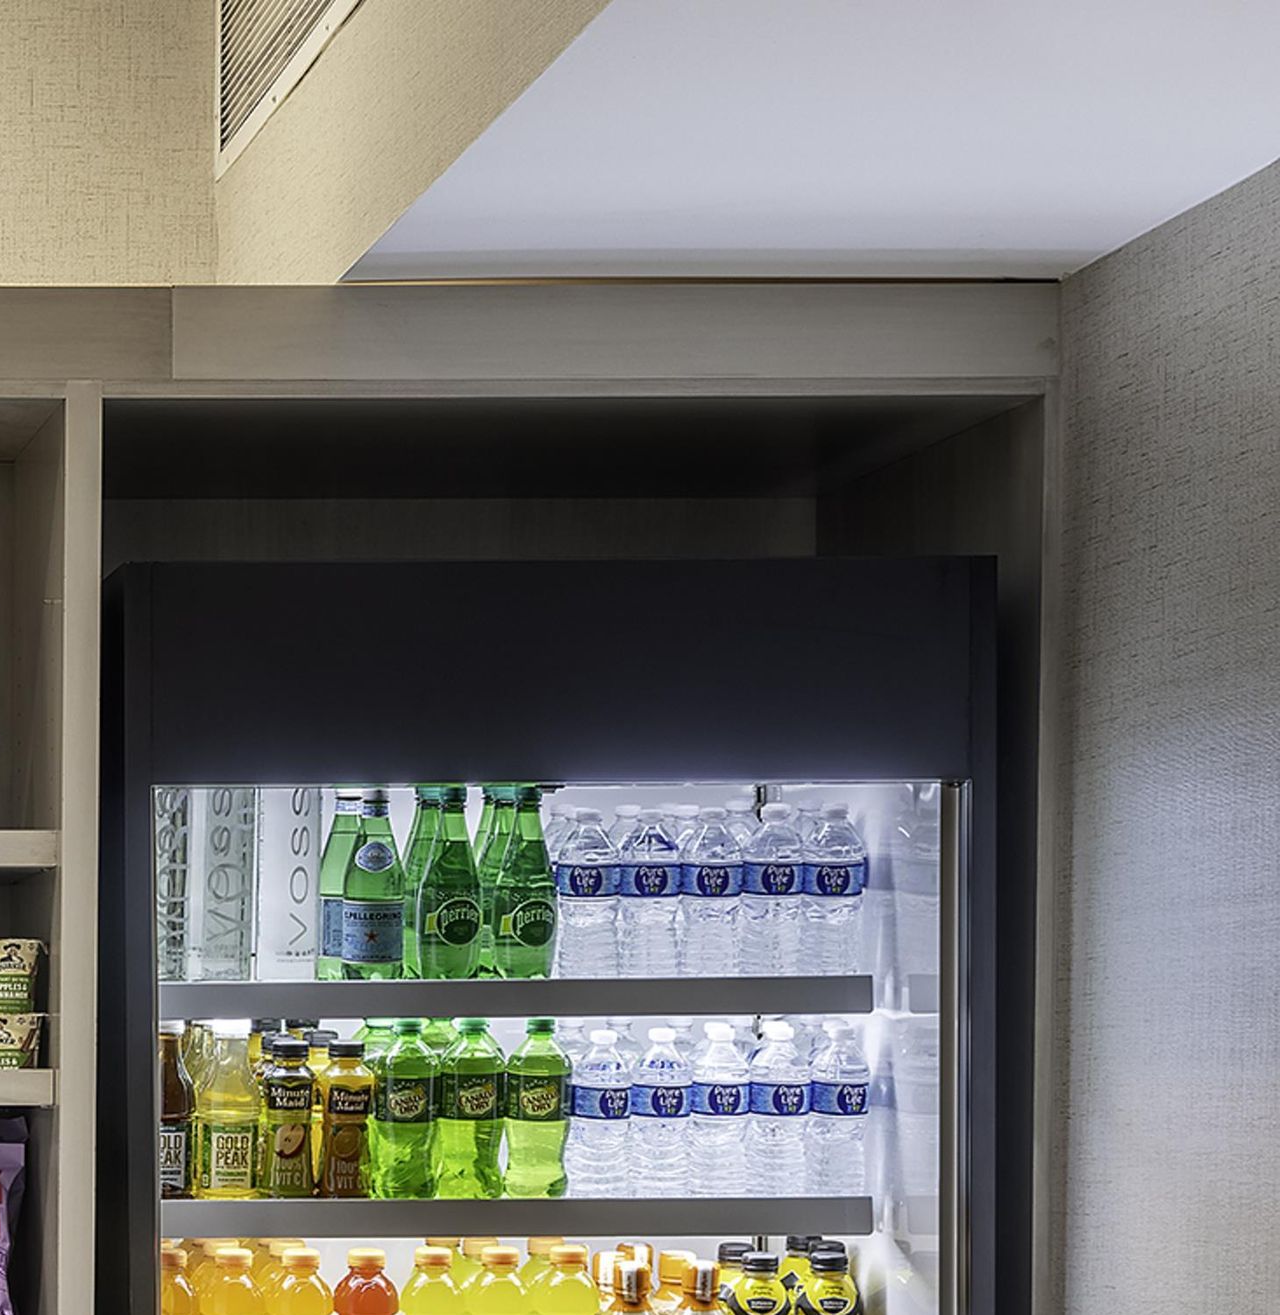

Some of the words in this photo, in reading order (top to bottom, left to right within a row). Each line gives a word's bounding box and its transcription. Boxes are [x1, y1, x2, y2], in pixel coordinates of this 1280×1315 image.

[289, 787, 311, 945] VOSS
[271, 1087, 310, 1097] Minute
[333, 1090, 369, 1102] Minute
[606, 1090, 628, 1100] Pure
[657, 1087, 680, 1098] Pure
[714, 1085, 737, 1096] Pure
[778, 1085, 801, 1096] Pure
[844, 1085, 866, 1096] Pure
[275, 1097, 305, 1108] Maid
[336, 1101, 366, 1112] Maid
[216, 1135, 249, 1150] GOLD
[216, 1151, 248, 1165] PEAK
